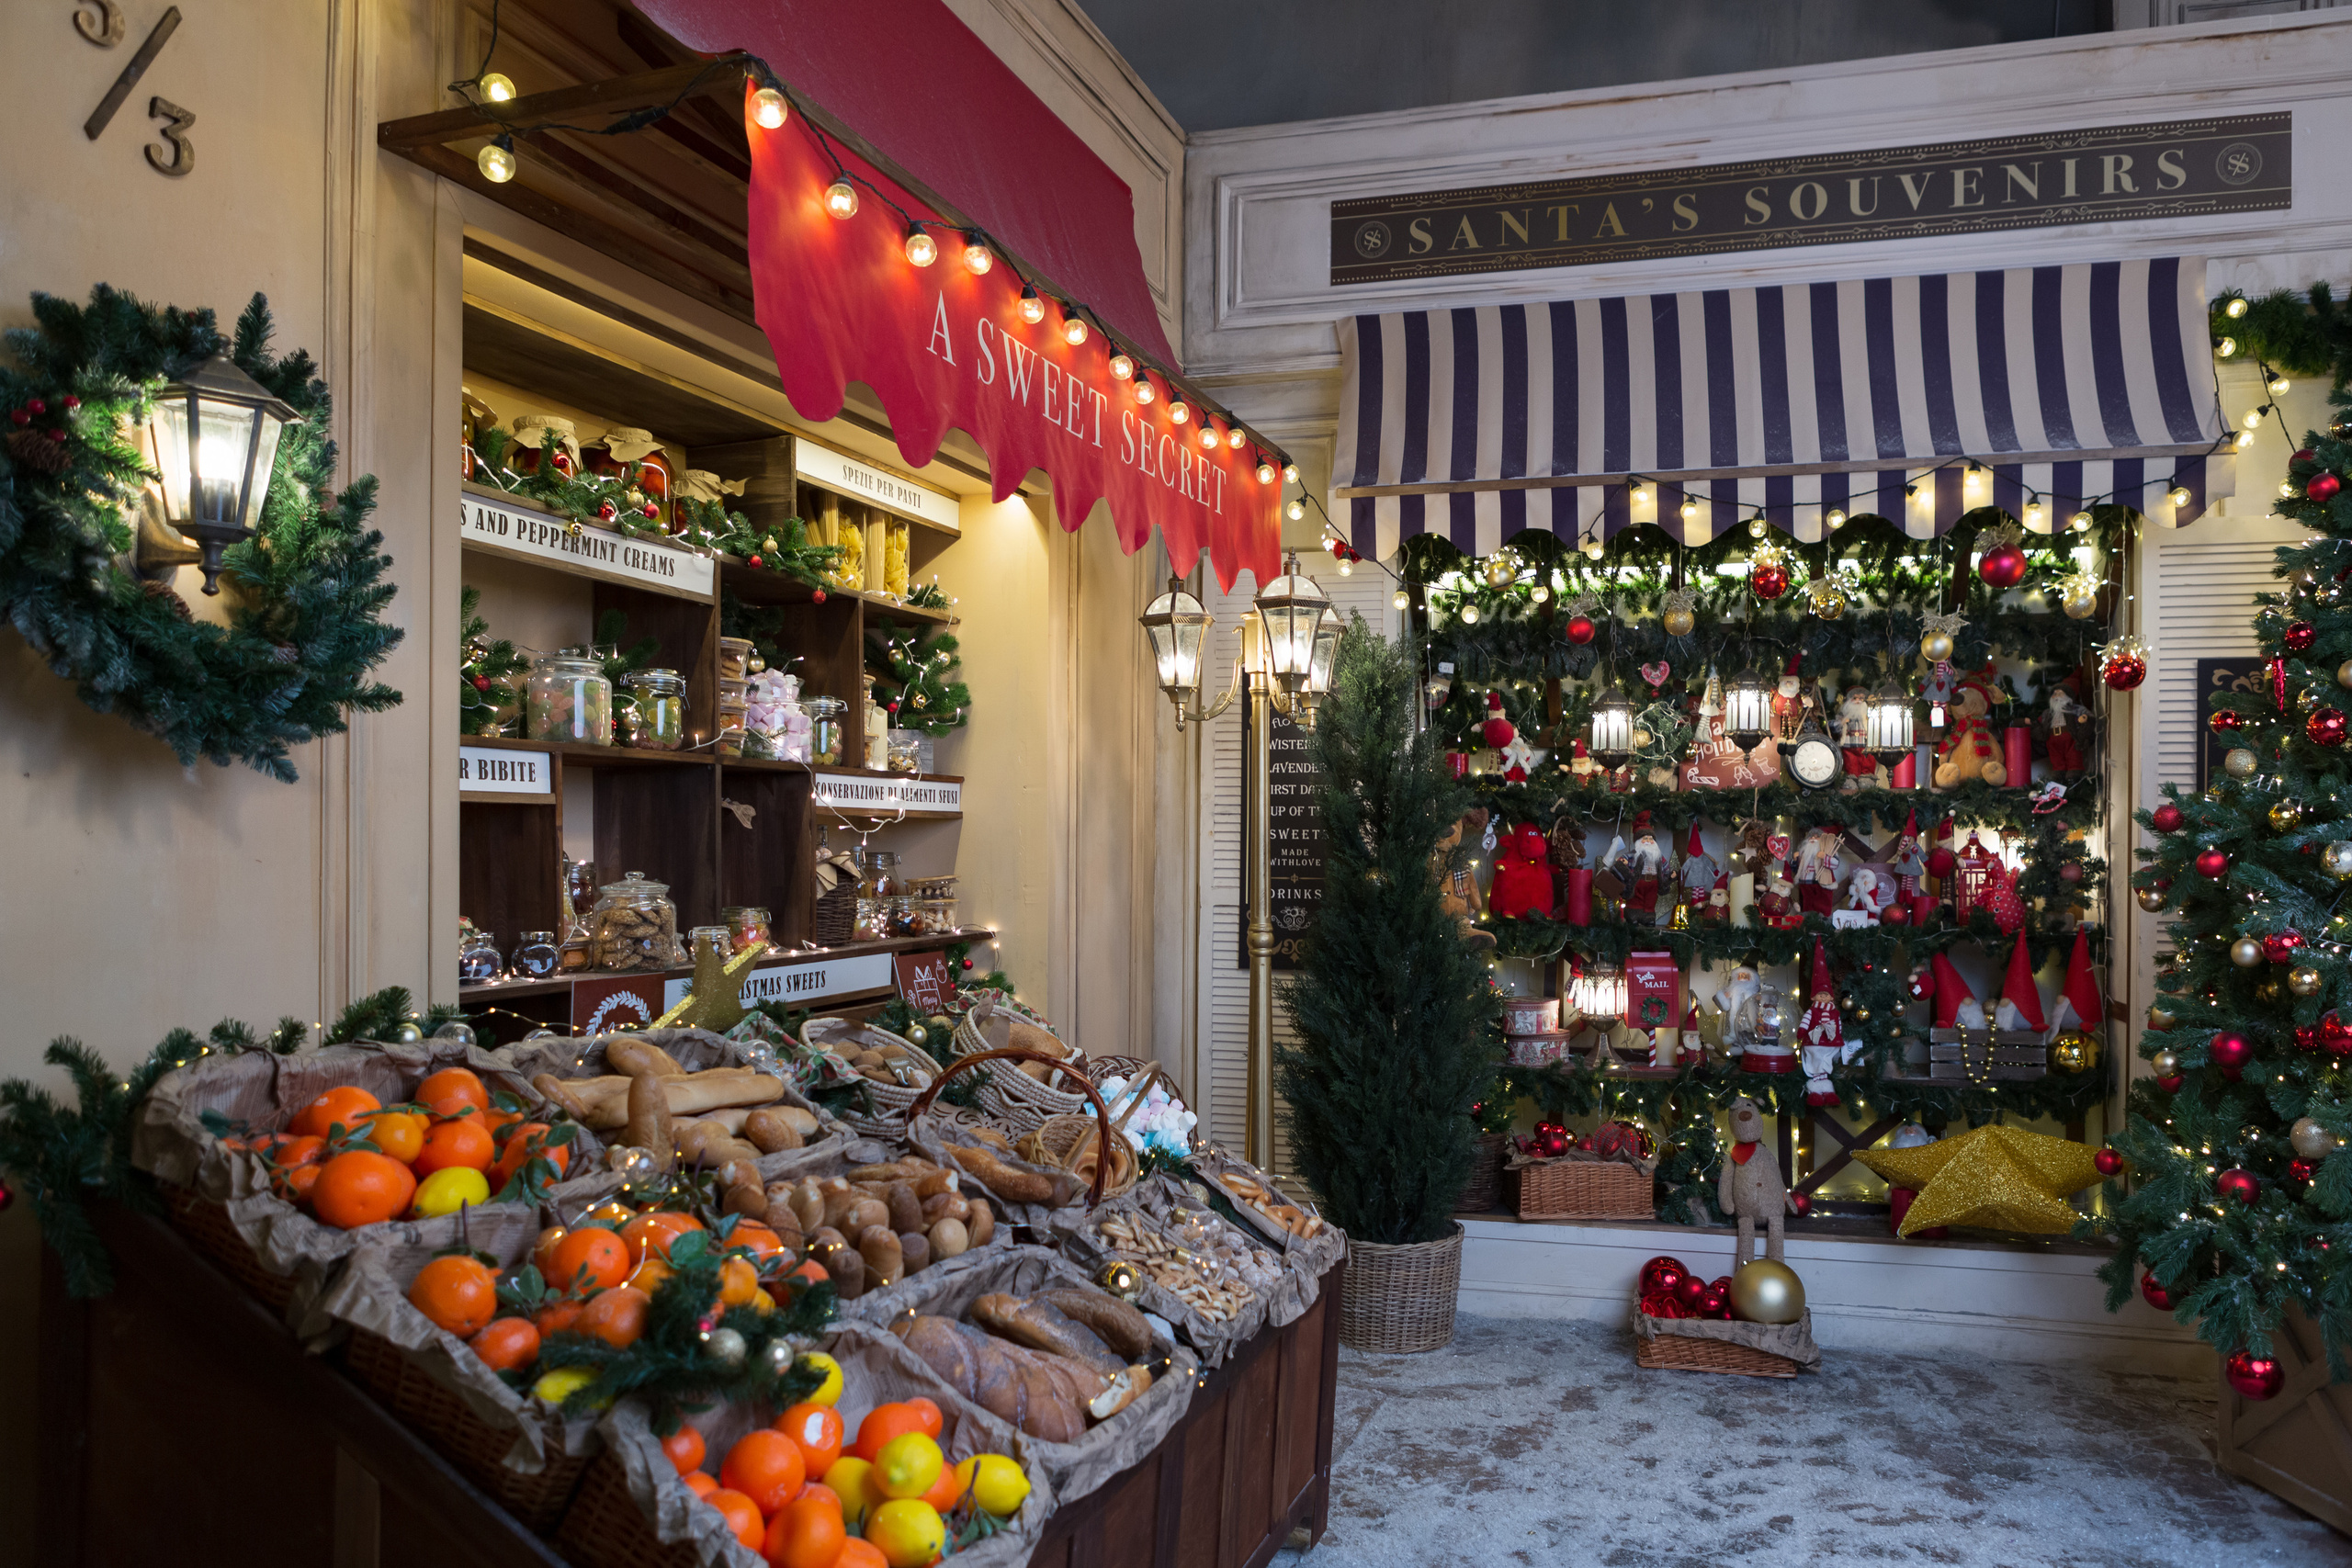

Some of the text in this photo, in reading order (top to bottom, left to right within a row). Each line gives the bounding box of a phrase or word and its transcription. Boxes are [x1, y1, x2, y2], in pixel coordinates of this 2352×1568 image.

[1408, 193, 1699, 255] SANTA'S
[1745, 148, 2188, 226] SOUVENIRS
[926, 289, 1227, 516] A SWEET SECRET
[842, 464, 921, 508] SPEZIE PER PASTI
[475, 507, 508, 536] AND
[516, 518, 616, 563] PEPPERMINT
[623, 547, 675, 578] CREAMS
[477, 759, 537, 783] BIBITE
[815, 782, 885, 801] CONSERVAZIONE
[901, 787, 936, 803] ALIMENTI
[939, 789, 957, 805] SFUSI
[1289, 806, 1305, 817] OF
[1281, 848, 1309, 856] MADE
[786, 970, 826, 993] SWEETS
